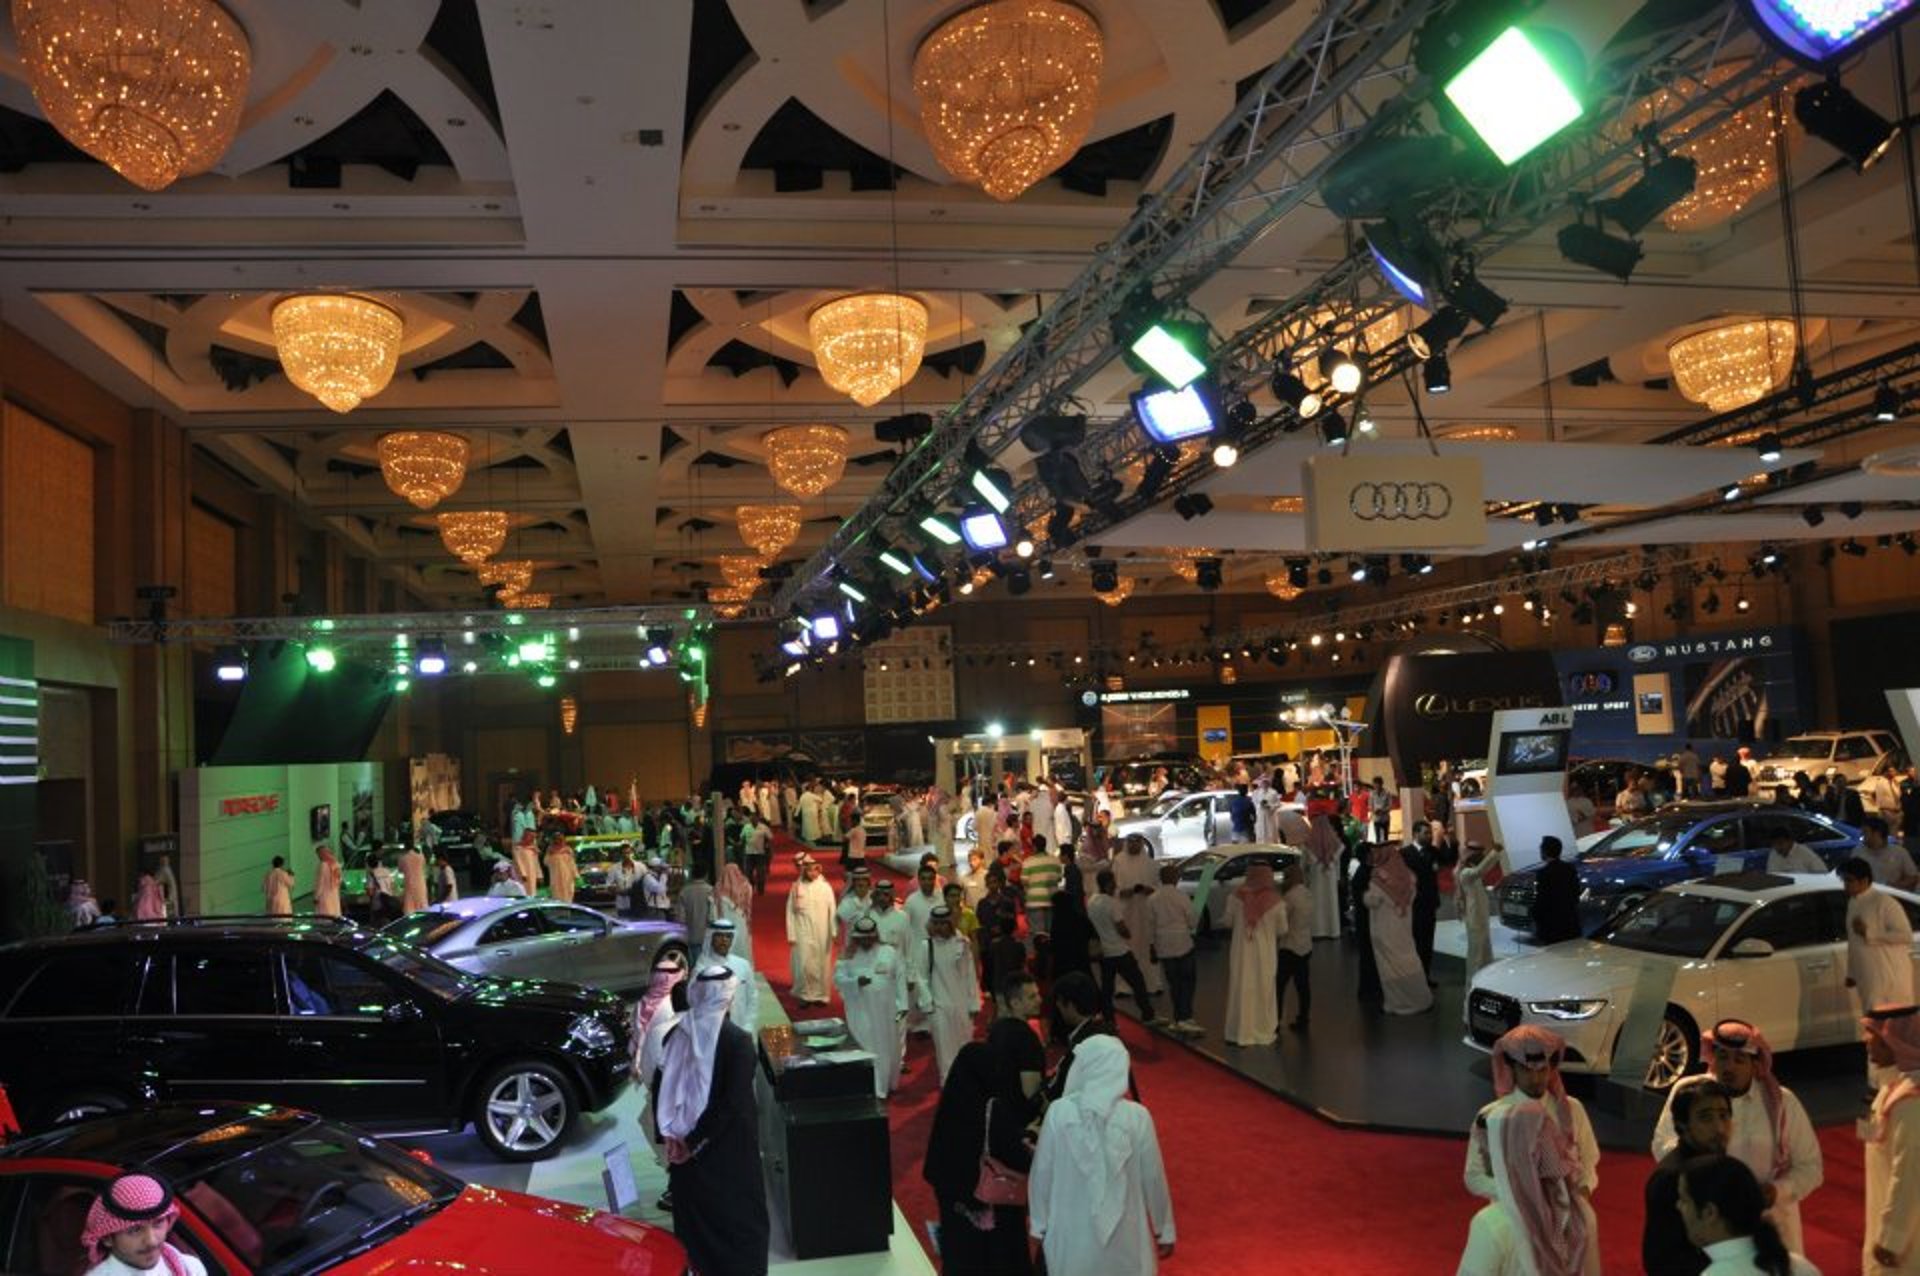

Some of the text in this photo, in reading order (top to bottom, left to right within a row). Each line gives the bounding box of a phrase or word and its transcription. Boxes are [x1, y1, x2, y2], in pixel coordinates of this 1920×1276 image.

[1664, 635, 1772, 656] MUSTANG
[1452, 696, 1544, 712] LEXUS
[220, 794, 279, 816] PORSCHE
